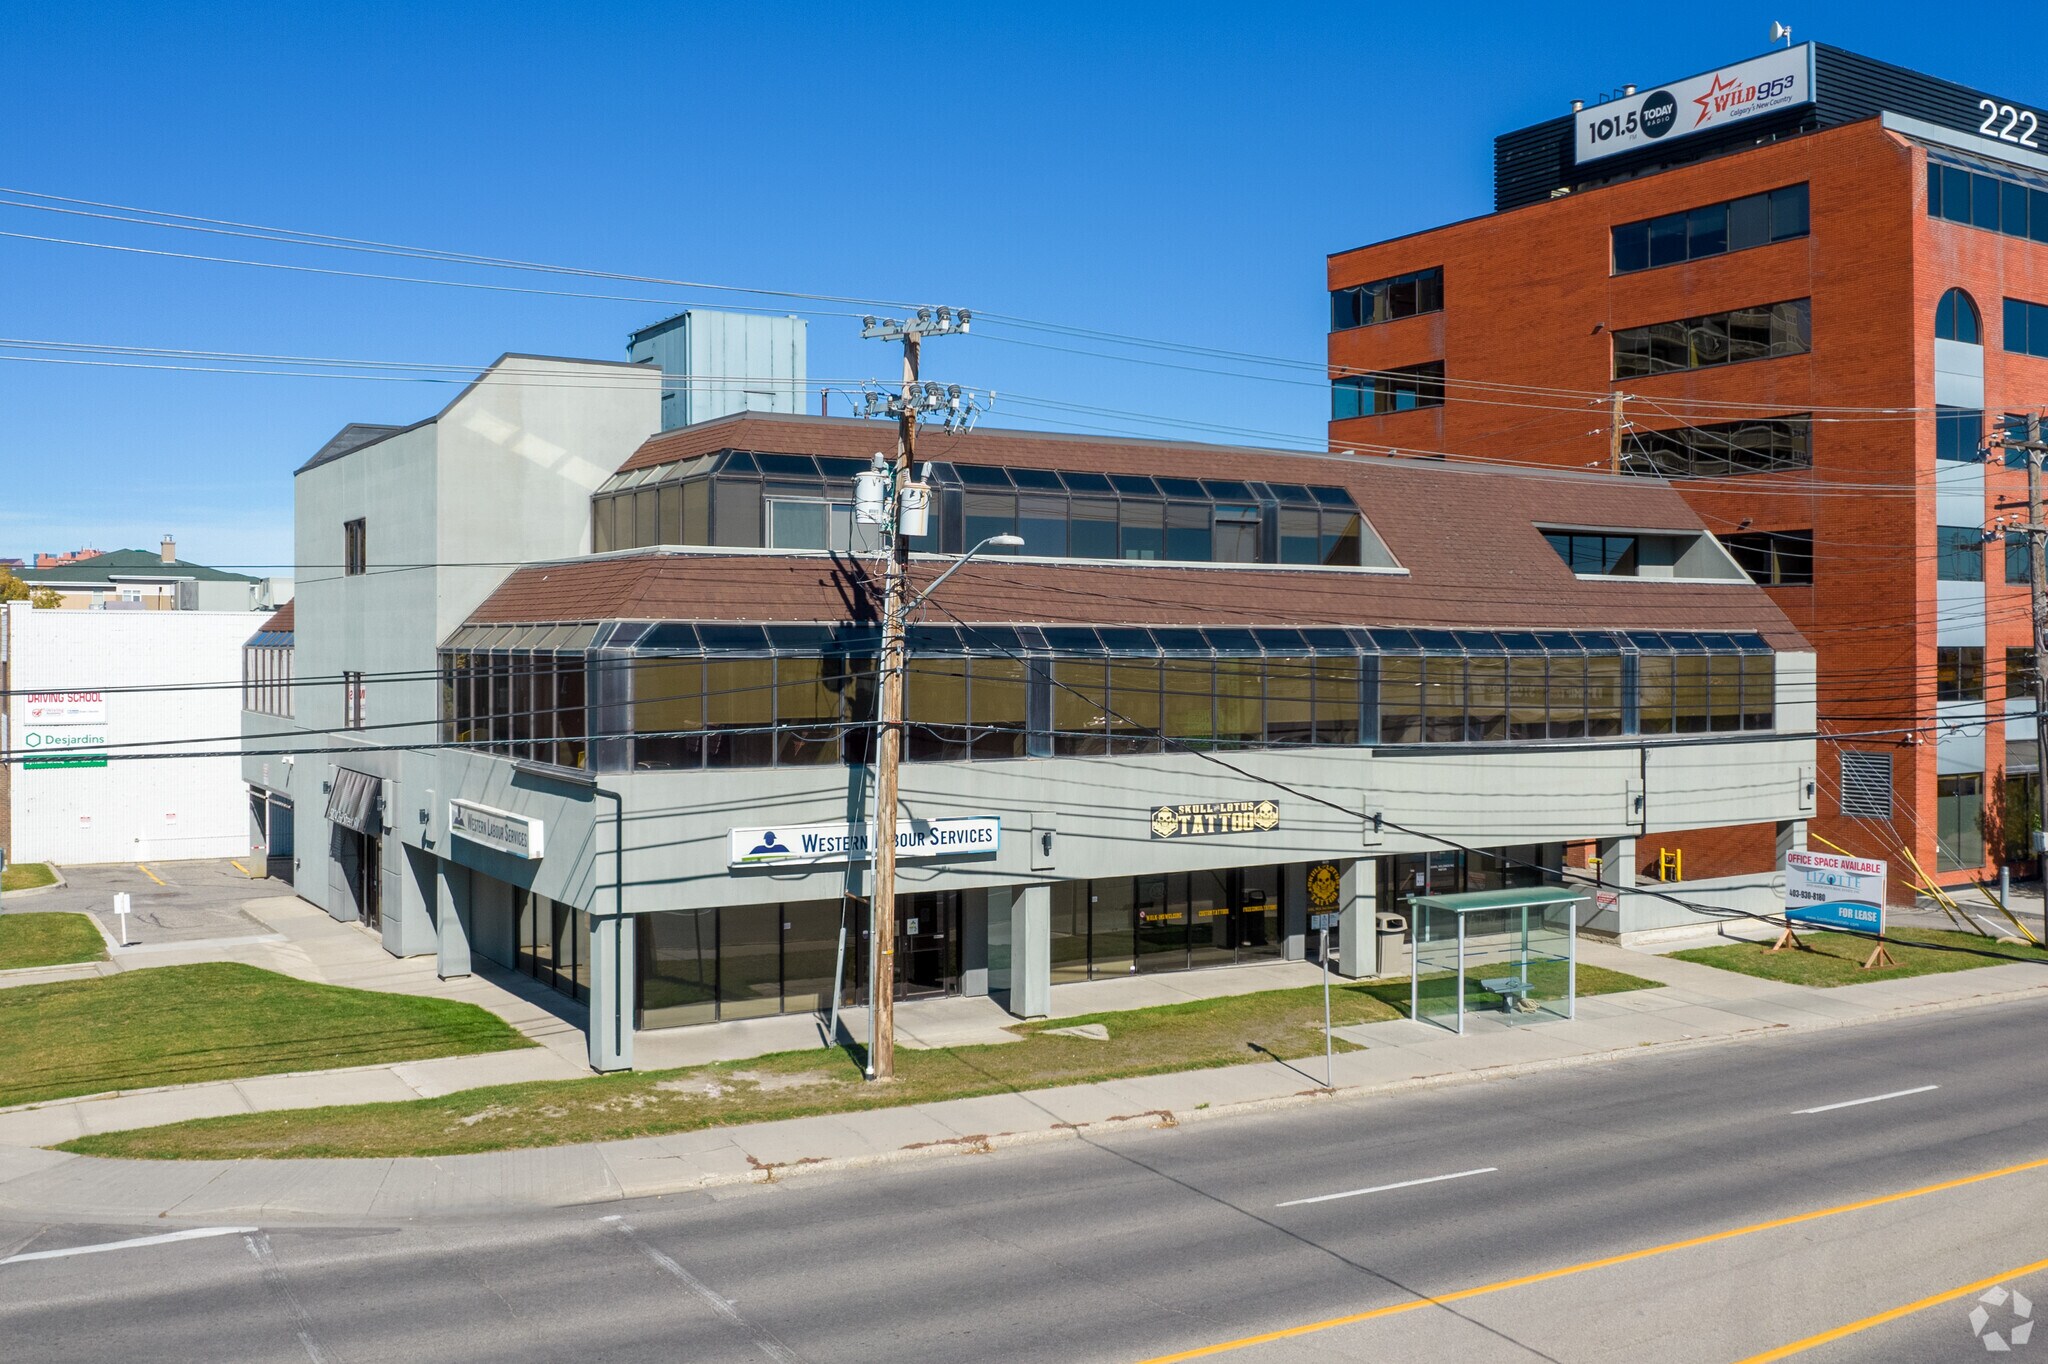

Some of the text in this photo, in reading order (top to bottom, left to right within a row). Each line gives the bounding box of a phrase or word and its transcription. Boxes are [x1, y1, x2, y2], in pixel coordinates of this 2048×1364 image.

[1714, 85, 1757, 113] WILD
[1756, 102, 1769, 111] New
[1769, 95, 1793, 106] Country
[1643, 103, 1674, 121] TODAY
[1589, 110, 1638, 144] 101.5
[1646, 116, 1670, 127] RADIO
[1979, 99, 2038, 149] 222
[27, 690, 103, 703] DRIVING SCHOOL
[45, 734, 105, 747] Desjardins
[1178, 803, 1214, 814] SKULL
[1219, 801, 1254, 812] LOTUS
[1177, 811, 1255, 835] TATTOO
[802, 827, 993, 853] WESTERN BOUR SERVICES
[1788, 853, 1881, 873] OFFICE SPACE AVAILABLE
[1839, 907, 1877, 922] FOR LEASE
